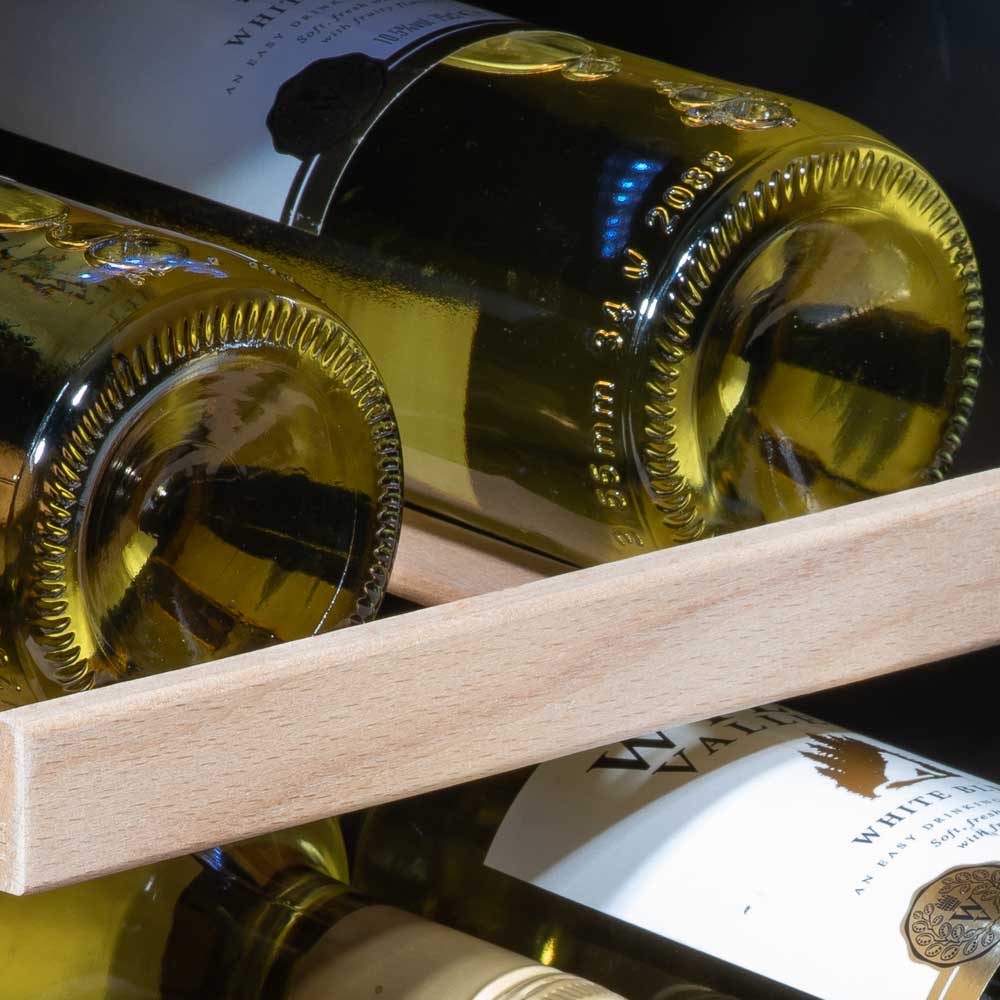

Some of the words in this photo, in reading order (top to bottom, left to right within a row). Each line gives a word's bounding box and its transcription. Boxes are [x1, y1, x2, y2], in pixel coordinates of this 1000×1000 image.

[224, 0, 301, 46] WHI
[645, 150, 736, 235] 2088
[851, 790, 952, 845] WHITE
[957, 829, 991, 848] with
[855, 875, 873, 895] AN
[877, 834, 916, 867] EASY
